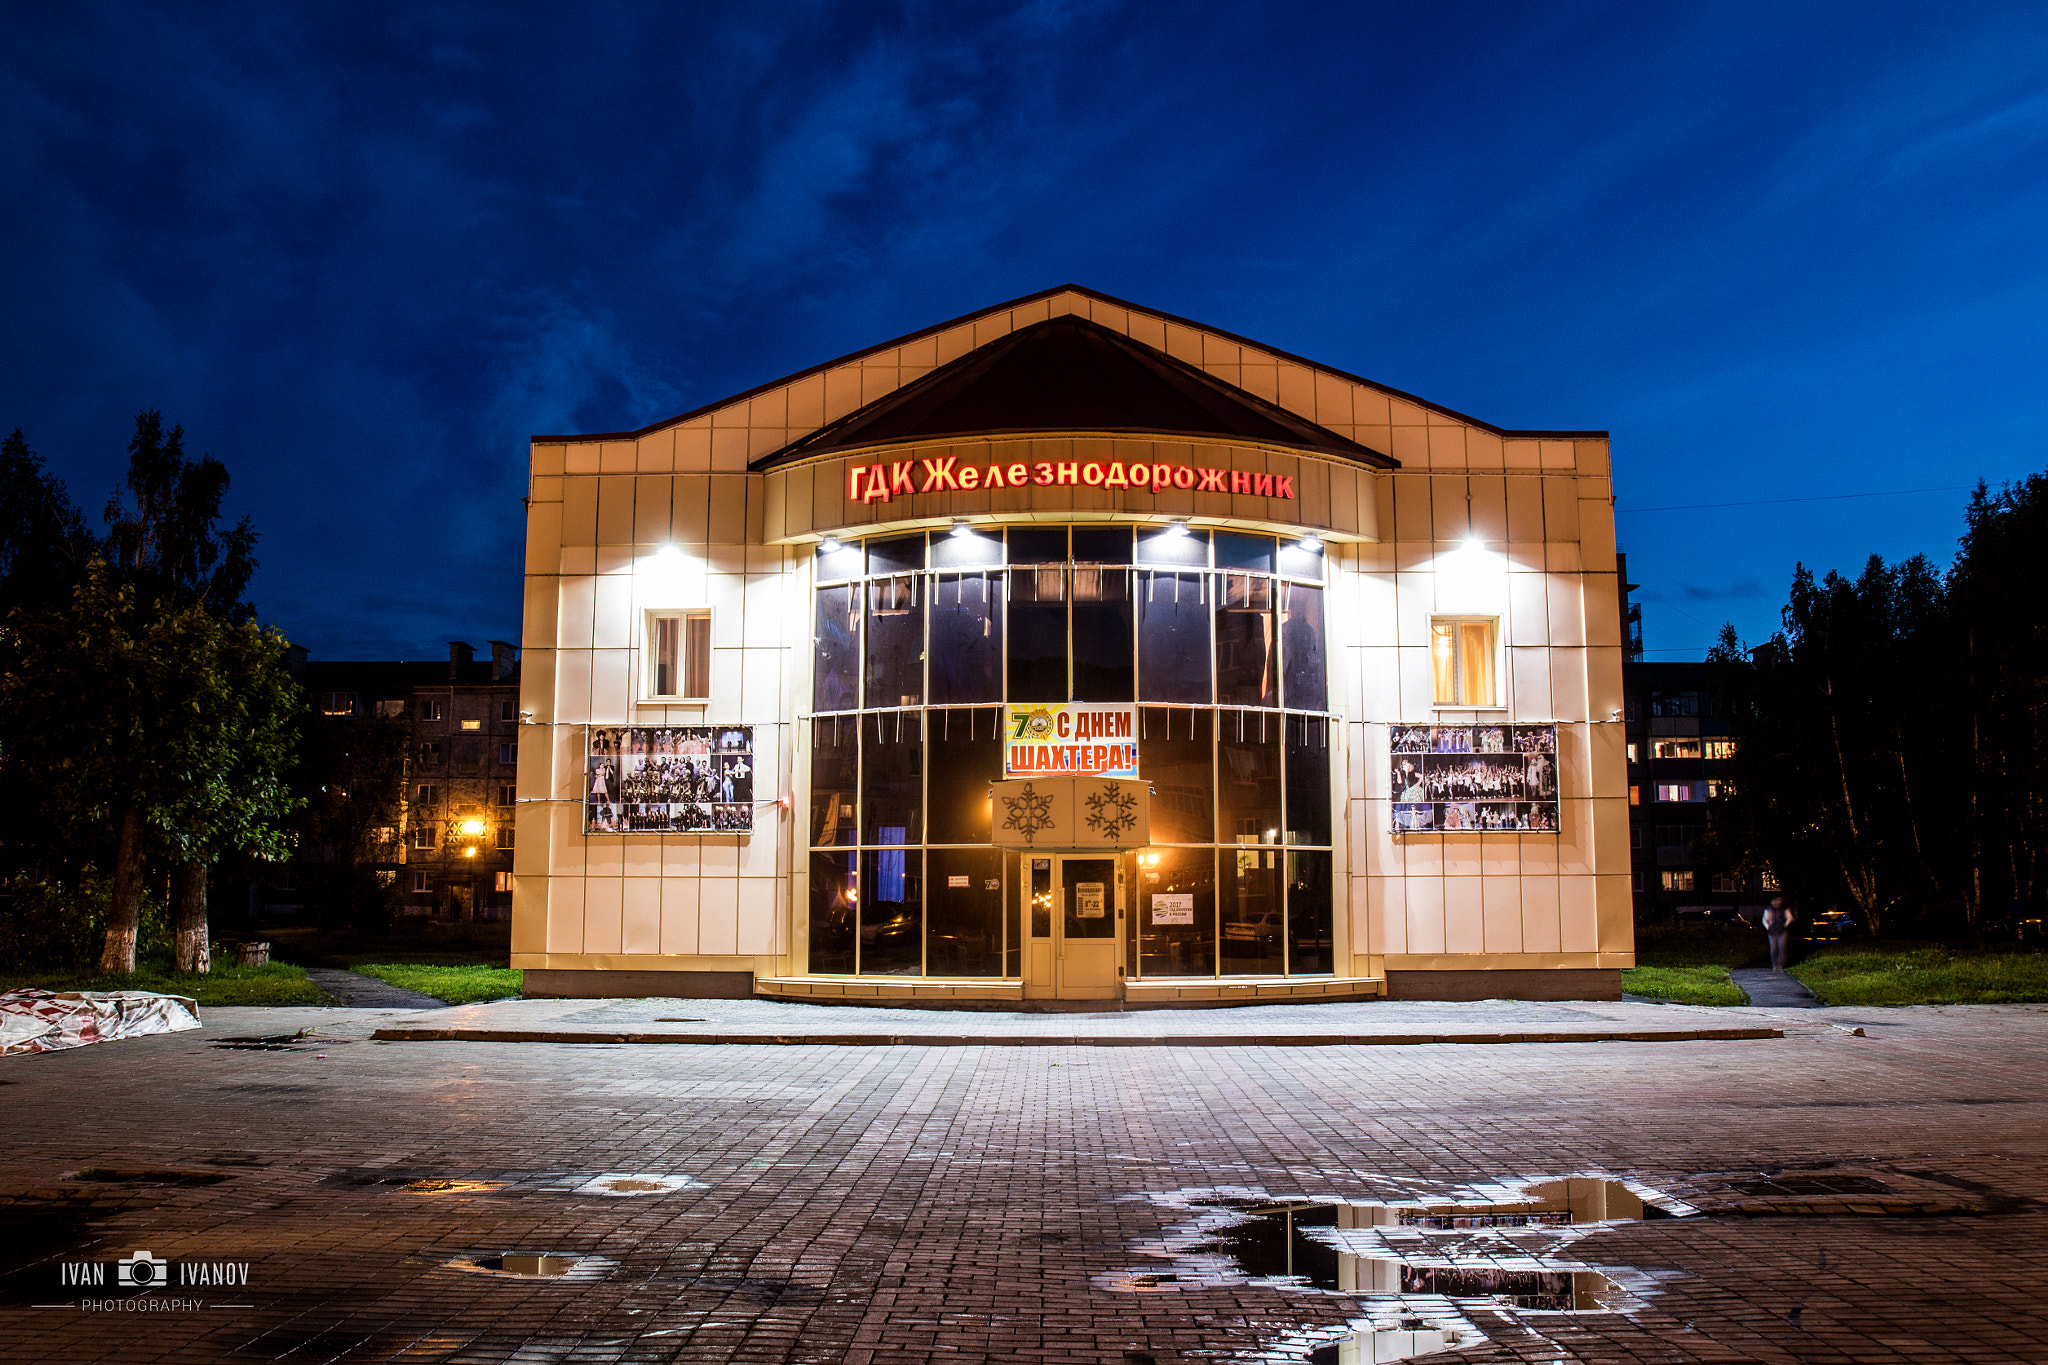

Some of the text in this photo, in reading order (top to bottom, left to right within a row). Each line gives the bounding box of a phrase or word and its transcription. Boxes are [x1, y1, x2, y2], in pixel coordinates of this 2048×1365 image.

[849, 456, 1296, 504] ГДК Железнодорожник
[1057, 711, 1070, 738] С
[1074, 711, 1132, 742] ДНЕМ
[1011, 744, 1132, 771] ШАХТЕРА!
